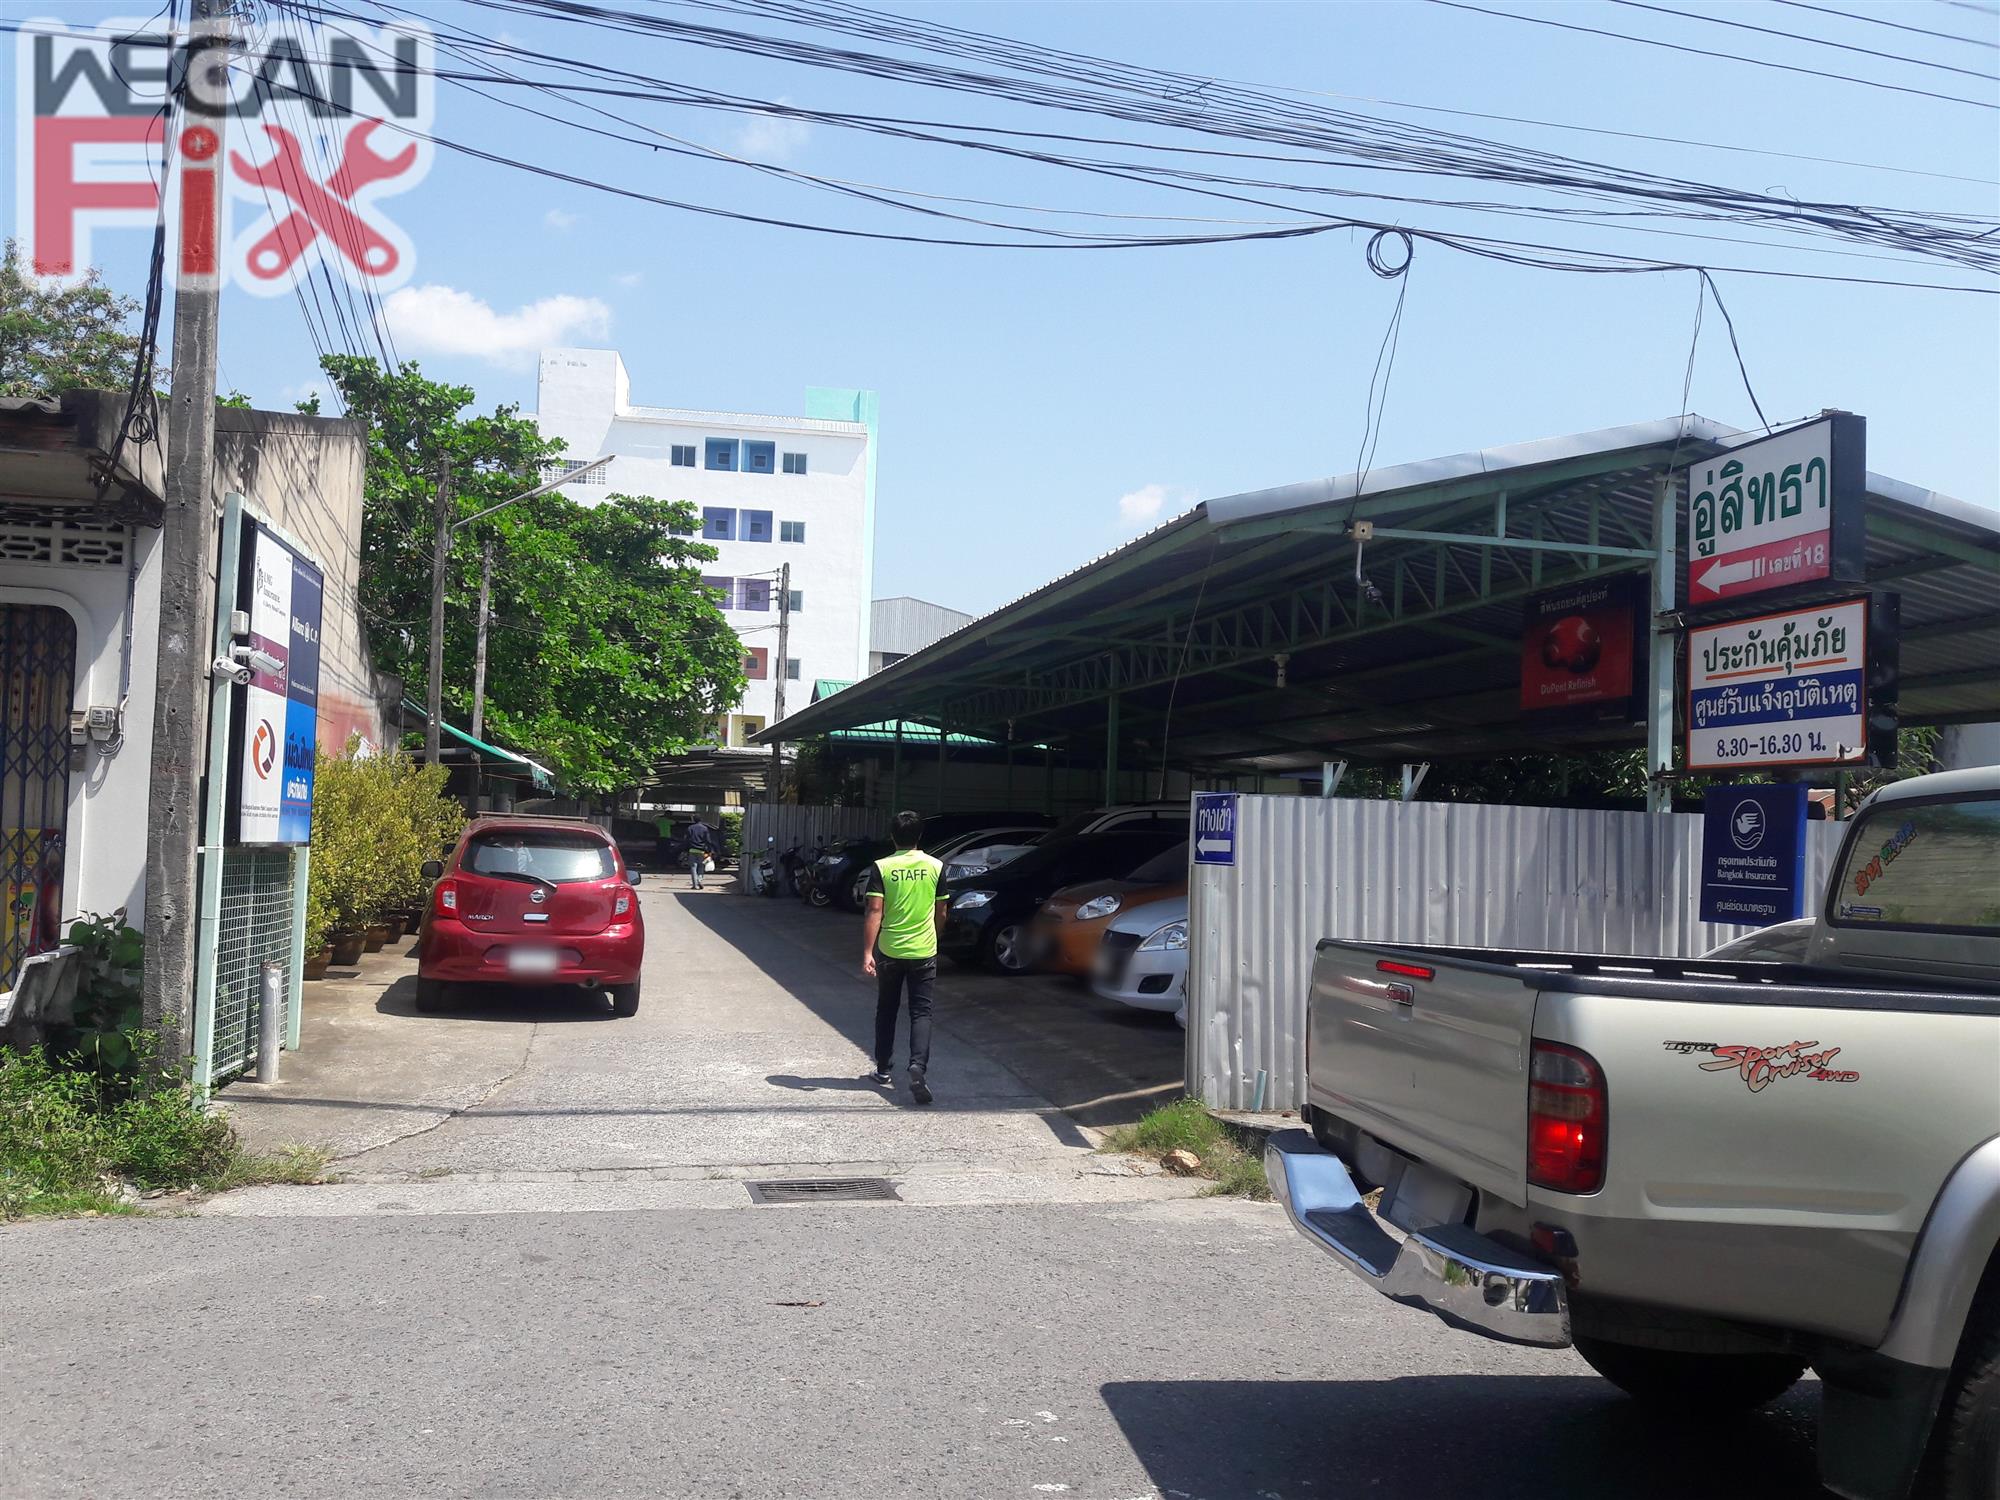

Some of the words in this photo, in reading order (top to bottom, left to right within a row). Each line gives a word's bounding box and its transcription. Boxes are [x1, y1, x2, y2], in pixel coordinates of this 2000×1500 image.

[1692, 456, 1826, 557] อู่สิทธา
[1769, 541, 1802, 575] เลขที่
[1804, 543, 1825, 566] 18
[1703, 616, 1846, 676] ประกันคุ้มภัย
[1695, 678, 1858, 728] ศูนย์รับแจ้งอุบัติเหตุ
[1717, 733, 1802, 758] 8.30-16.30
[1198, 800, 1232, 832] ทางเข้า
[891, 869, 928, 882] STAFF
[1717, 869, 1744, 881] Bangkok
[1745, 870, 1777, 881] Insurance
[1698, 1040, 1819, 1082] Sport
[1747, 1047, 1841, 1093] Cruiser
[1806, 1067, 1860, 1083] 4WD
